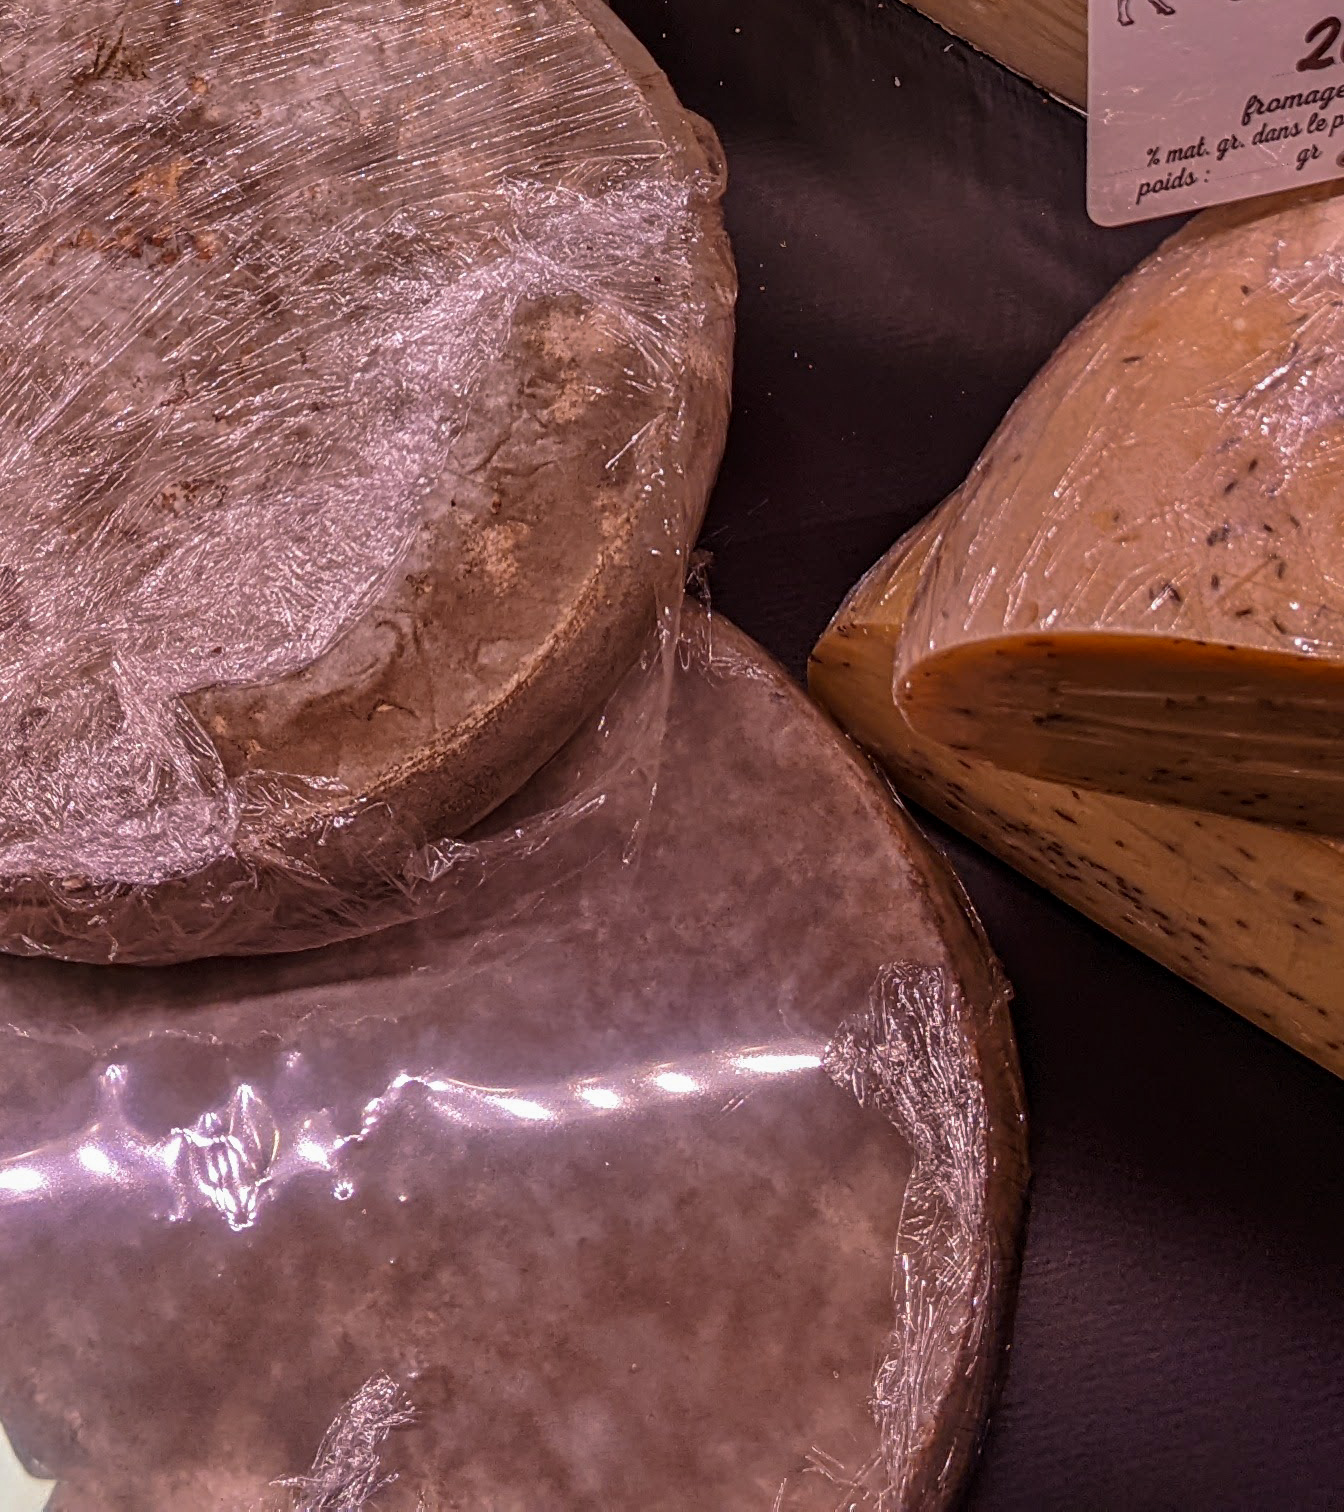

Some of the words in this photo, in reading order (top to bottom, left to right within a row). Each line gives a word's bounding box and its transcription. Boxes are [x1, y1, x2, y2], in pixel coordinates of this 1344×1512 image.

[1165, 137, 1210, 163] mat.
[1216, 132, 1245, 159] gr.
[1251, 118, 1304, 146] dans
[1306, 112, 1327, 133] le
[1135, 172, 1198, 204] poids
[1296, 144, 1322, 170] gr
